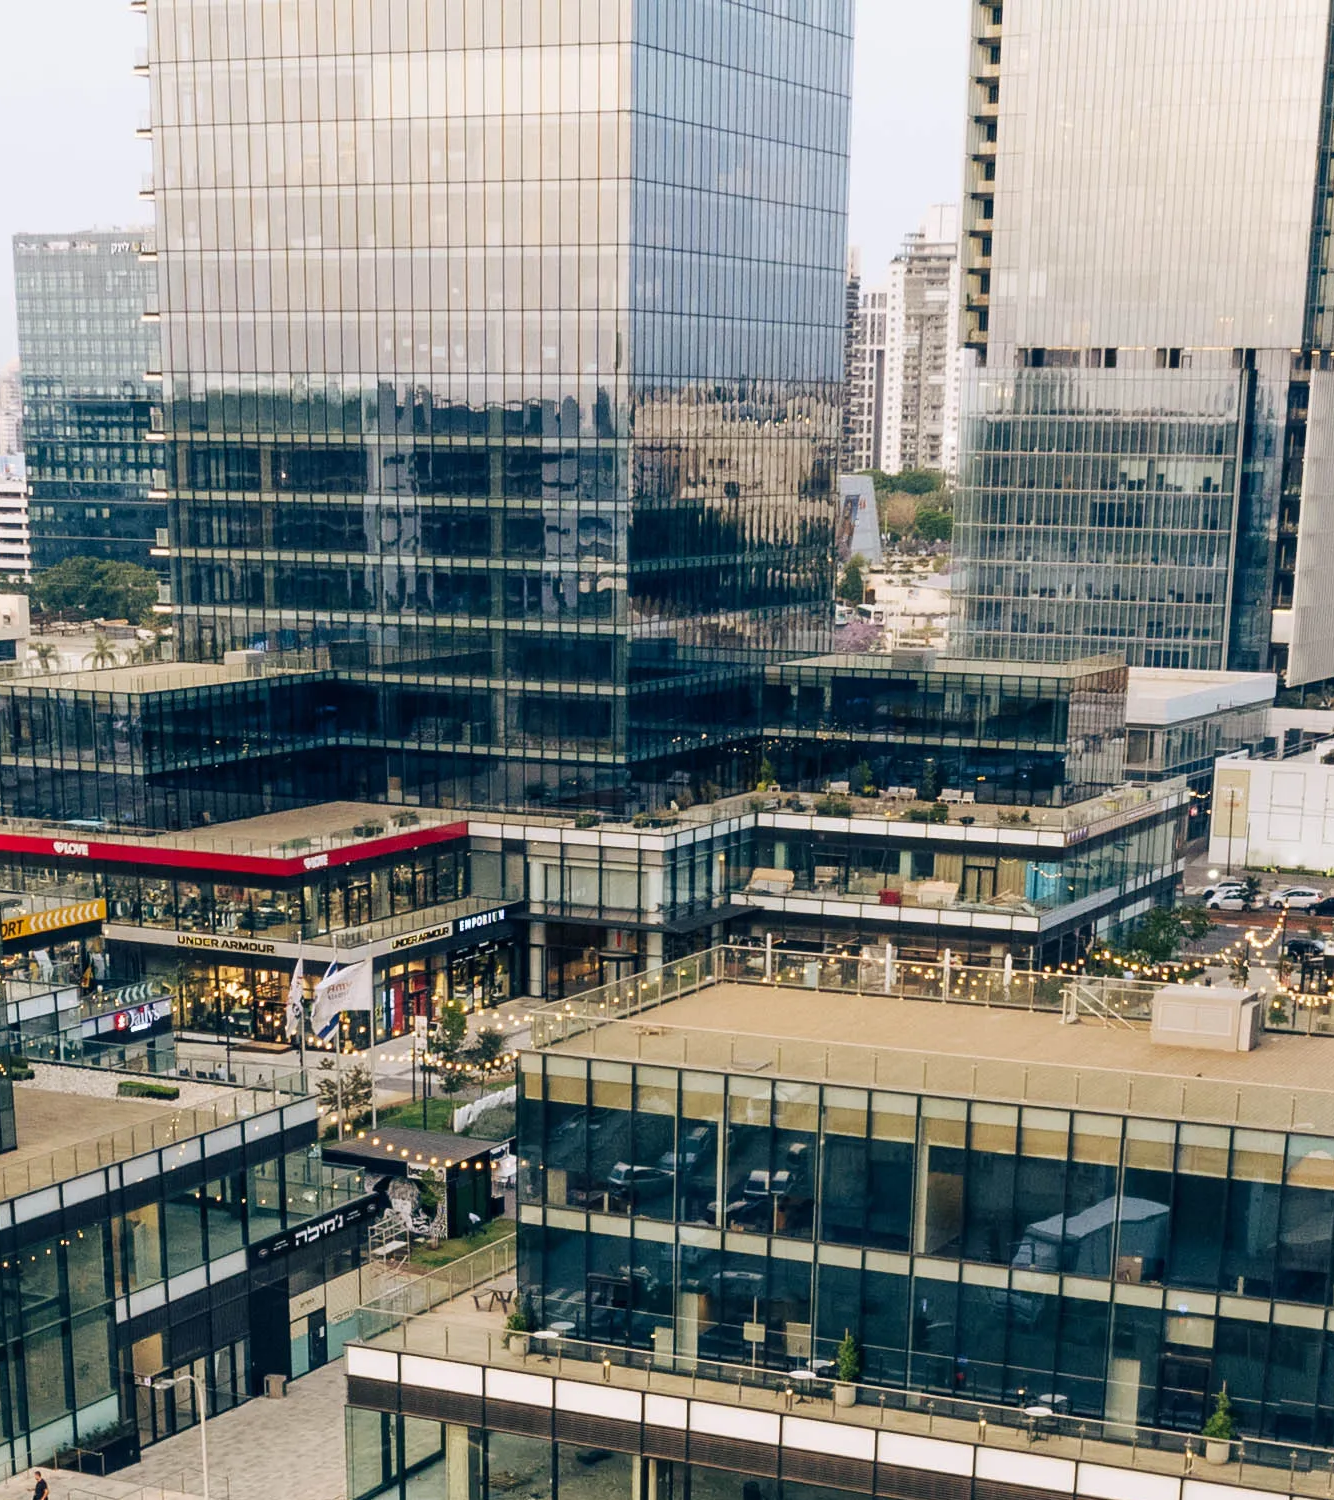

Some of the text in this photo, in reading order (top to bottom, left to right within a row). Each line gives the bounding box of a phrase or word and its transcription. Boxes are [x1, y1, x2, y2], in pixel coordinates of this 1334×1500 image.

[459, 909, 505, 932] EMPORIUM
[178, 935, 275, 954] UNDER ARMOUR
[391, 926, 450, 950] UNDER ARMOUR
